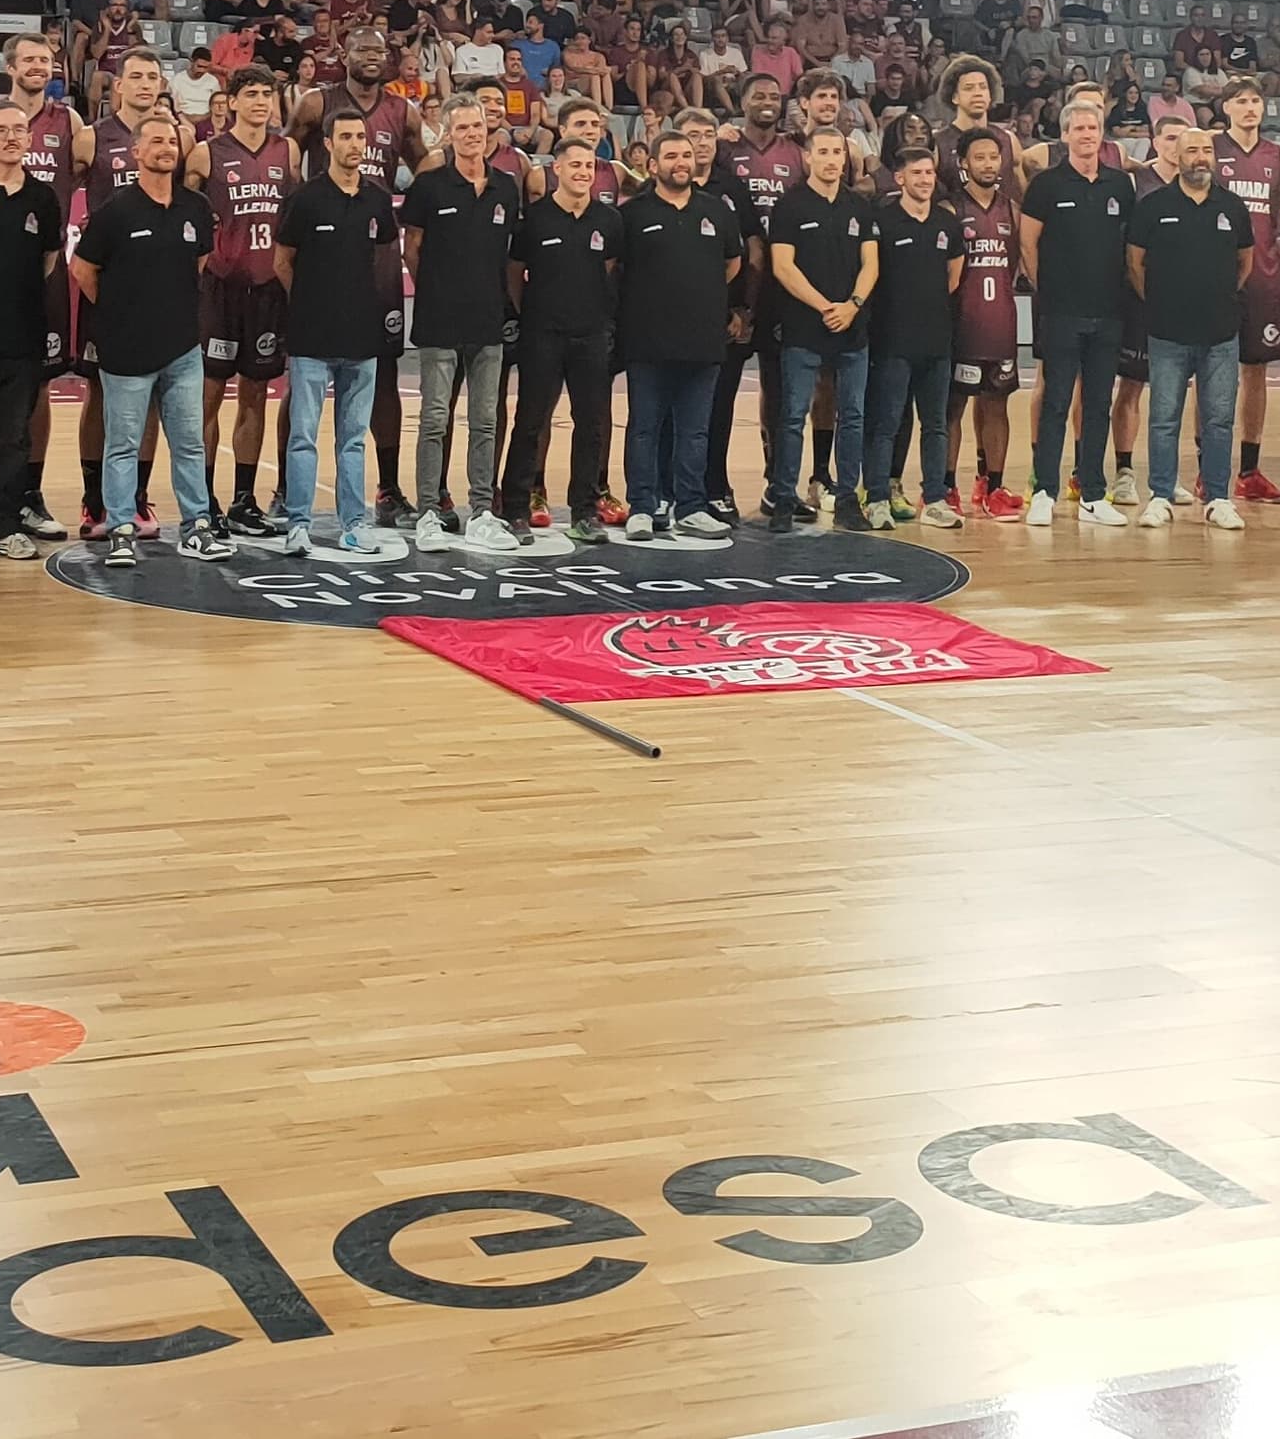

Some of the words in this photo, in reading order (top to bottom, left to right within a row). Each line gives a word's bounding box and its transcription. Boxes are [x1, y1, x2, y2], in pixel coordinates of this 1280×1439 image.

[1228, 180, 1270, 199] AMARA
[249, 223, 272, 250] 13
[983, 276, 996, 302] 0
[237, 564, 620, 590] Clínica
[262, 571, 903, 609] NovAliança
